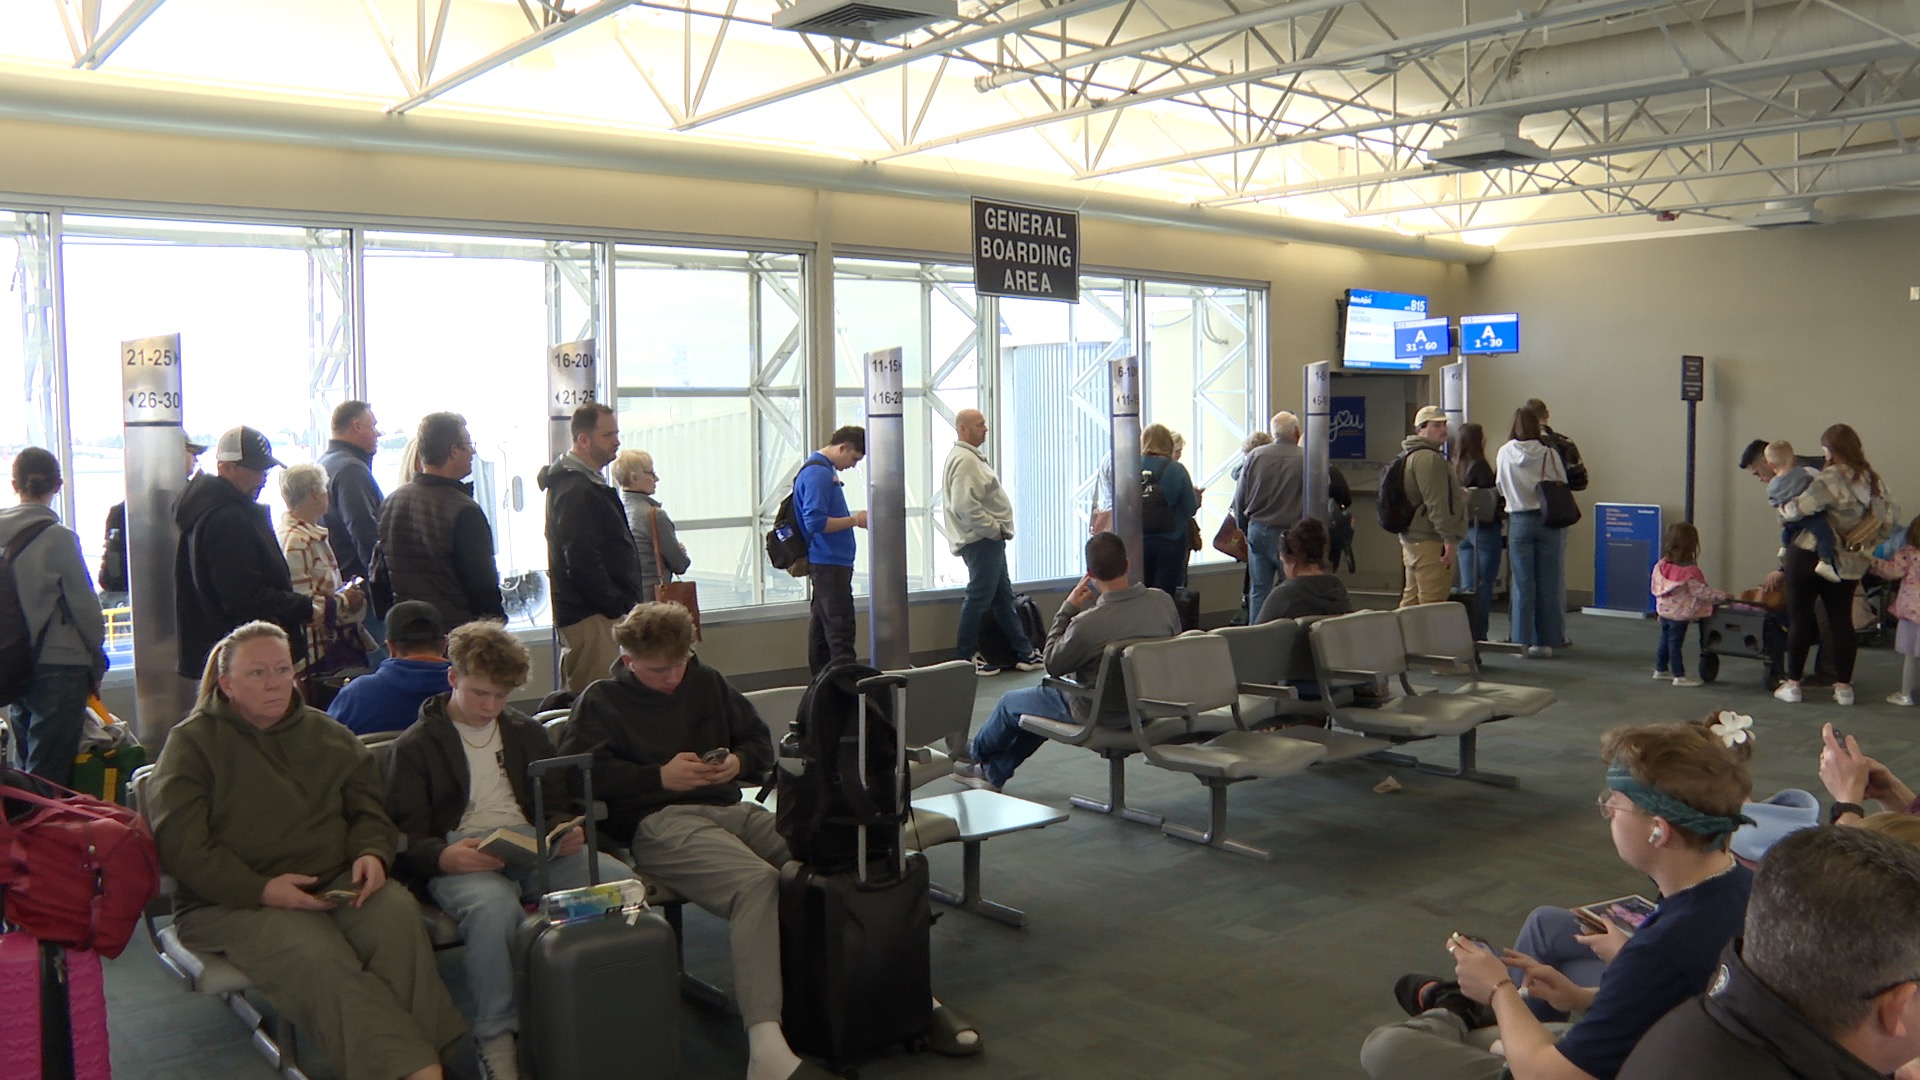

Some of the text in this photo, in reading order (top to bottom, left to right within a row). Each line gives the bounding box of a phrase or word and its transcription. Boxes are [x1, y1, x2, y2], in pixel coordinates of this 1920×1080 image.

[984, 207, 1067, 238] GENERAL
[981, 236, 1072, 268] BOARDING
[1003, 268, 1053, 293] AREA
[1411, 299, 1426, 313] B15
[1415, 329, 1427, 343] A
[1481, 325, 1495, 339] A
[1405, 343, 1418, 352] 31
[1424, 341, 1437, 350] 60
[1489, 338, 1503, 347] 30
[126, 348, 172, 366] 21-25
[554, 353, 589, 368] 16-20
[872, 359, 898, 372] 11-15
[137, 391, 180, 409] 26-30
[1328, 410, 1364, 442] you
